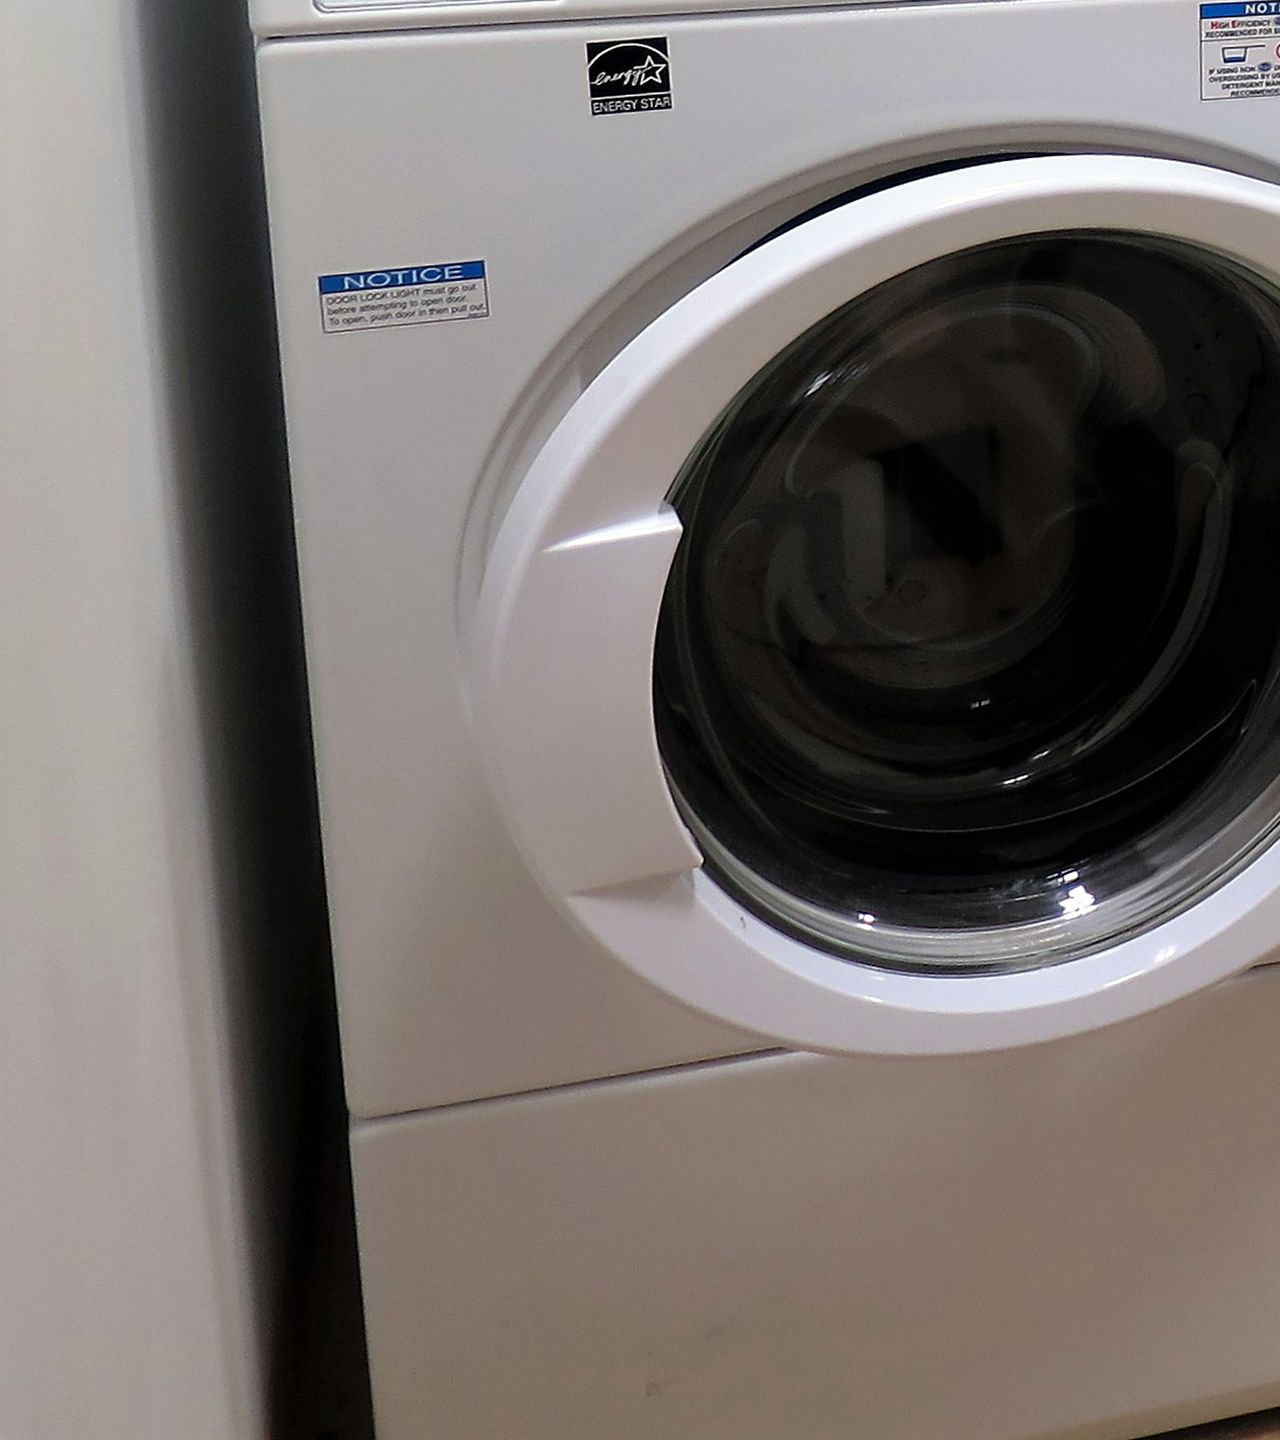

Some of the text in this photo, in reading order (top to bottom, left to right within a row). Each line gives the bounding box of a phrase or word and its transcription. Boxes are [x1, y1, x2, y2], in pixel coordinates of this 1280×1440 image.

[1205, 29, 1257, 38] RECOMMENDED
[1222, 80, 1263, 90] DETERGENT
[593, 97, 670, 113] ENERGY STAR
[343, 265, 463, 289] NOTICE
[326, 295, 357, 305] DOOR
[361, 292, 386, 301] LOCK
[390, 289, 419, 298] LIGHT
[423, 287, 446, 295] must
[448, 286, 458, 295] go
[328, 306, 356, 315] before
[359, 301, 407, 313] attempting
[409, 298, 418, 307] to
[421, 297, 443, 308] open
[370, 313, 392, 323] push
[395, 310, 415, 318] door
[429, 307, 448, 315] then
[451, 304, 467, 314] pull
